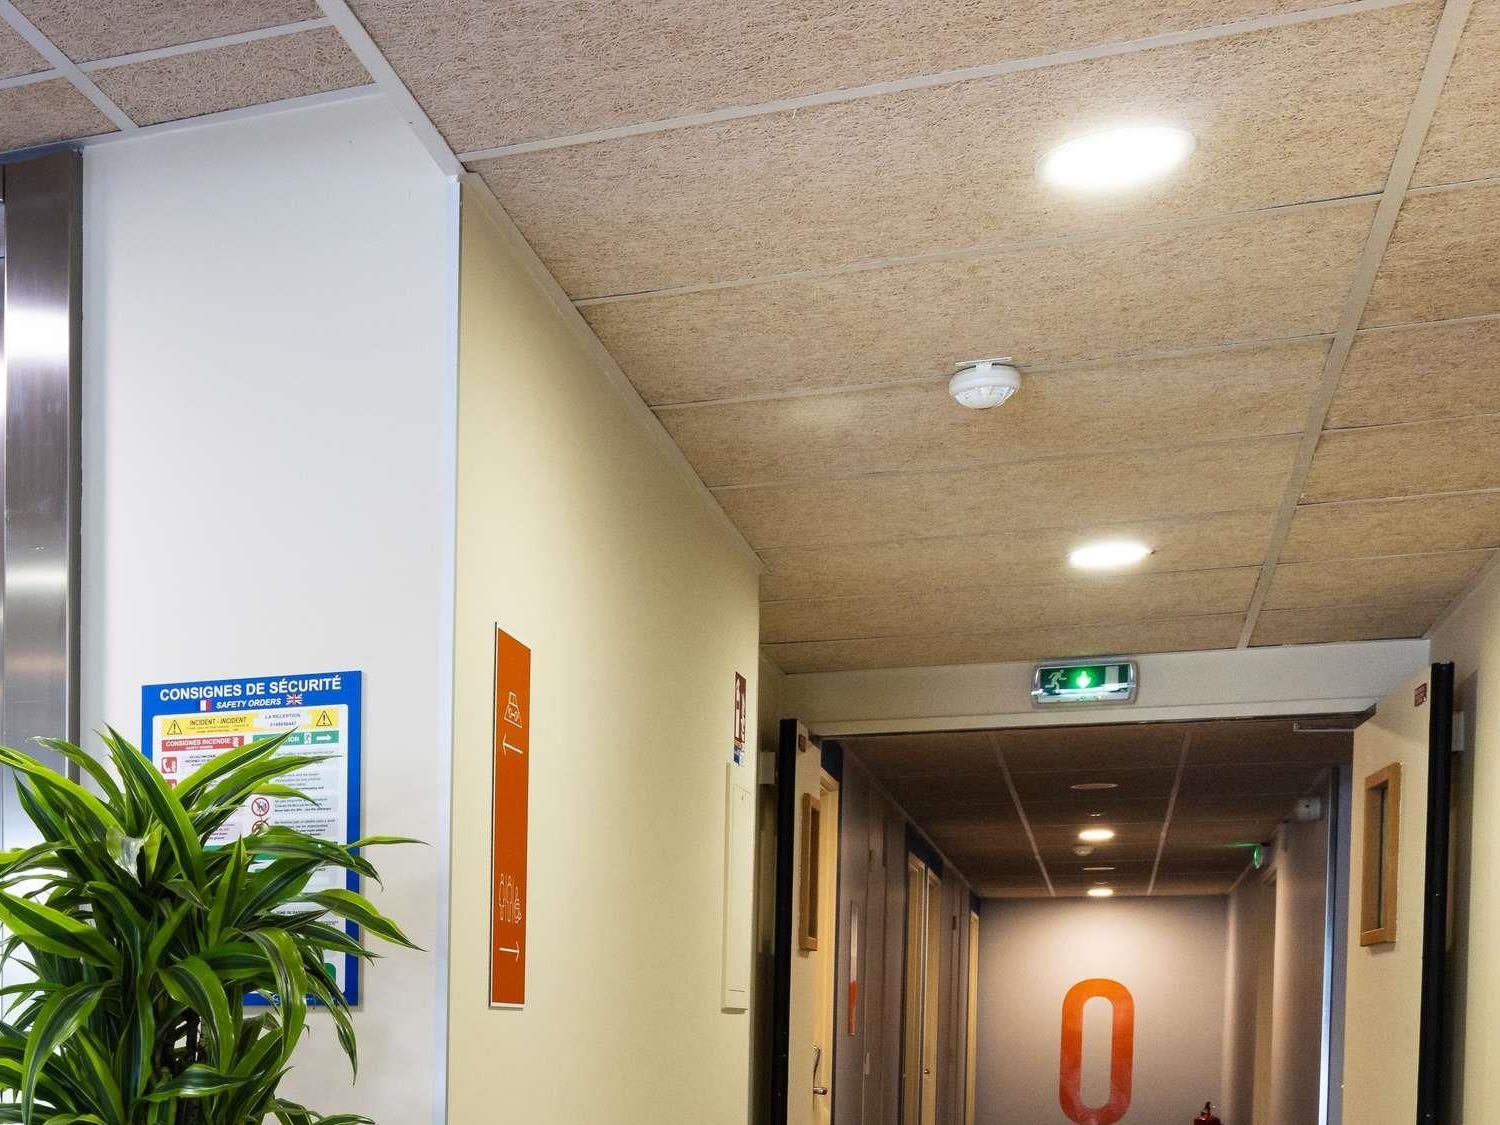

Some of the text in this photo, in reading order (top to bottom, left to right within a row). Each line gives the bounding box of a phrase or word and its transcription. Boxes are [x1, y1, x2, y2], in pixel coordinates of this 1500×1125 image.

[160, 674, 342, 701] CONSIGNES DE SÉCURITÉ
[216, 698, 282, 709] SAFETY ORDERS
[189, 718, 216, 726] INCIDENT
[220, 716, 247, 724] INCIDENT
[165, 737, 231, 747] CONSIGNES INCENDIE
